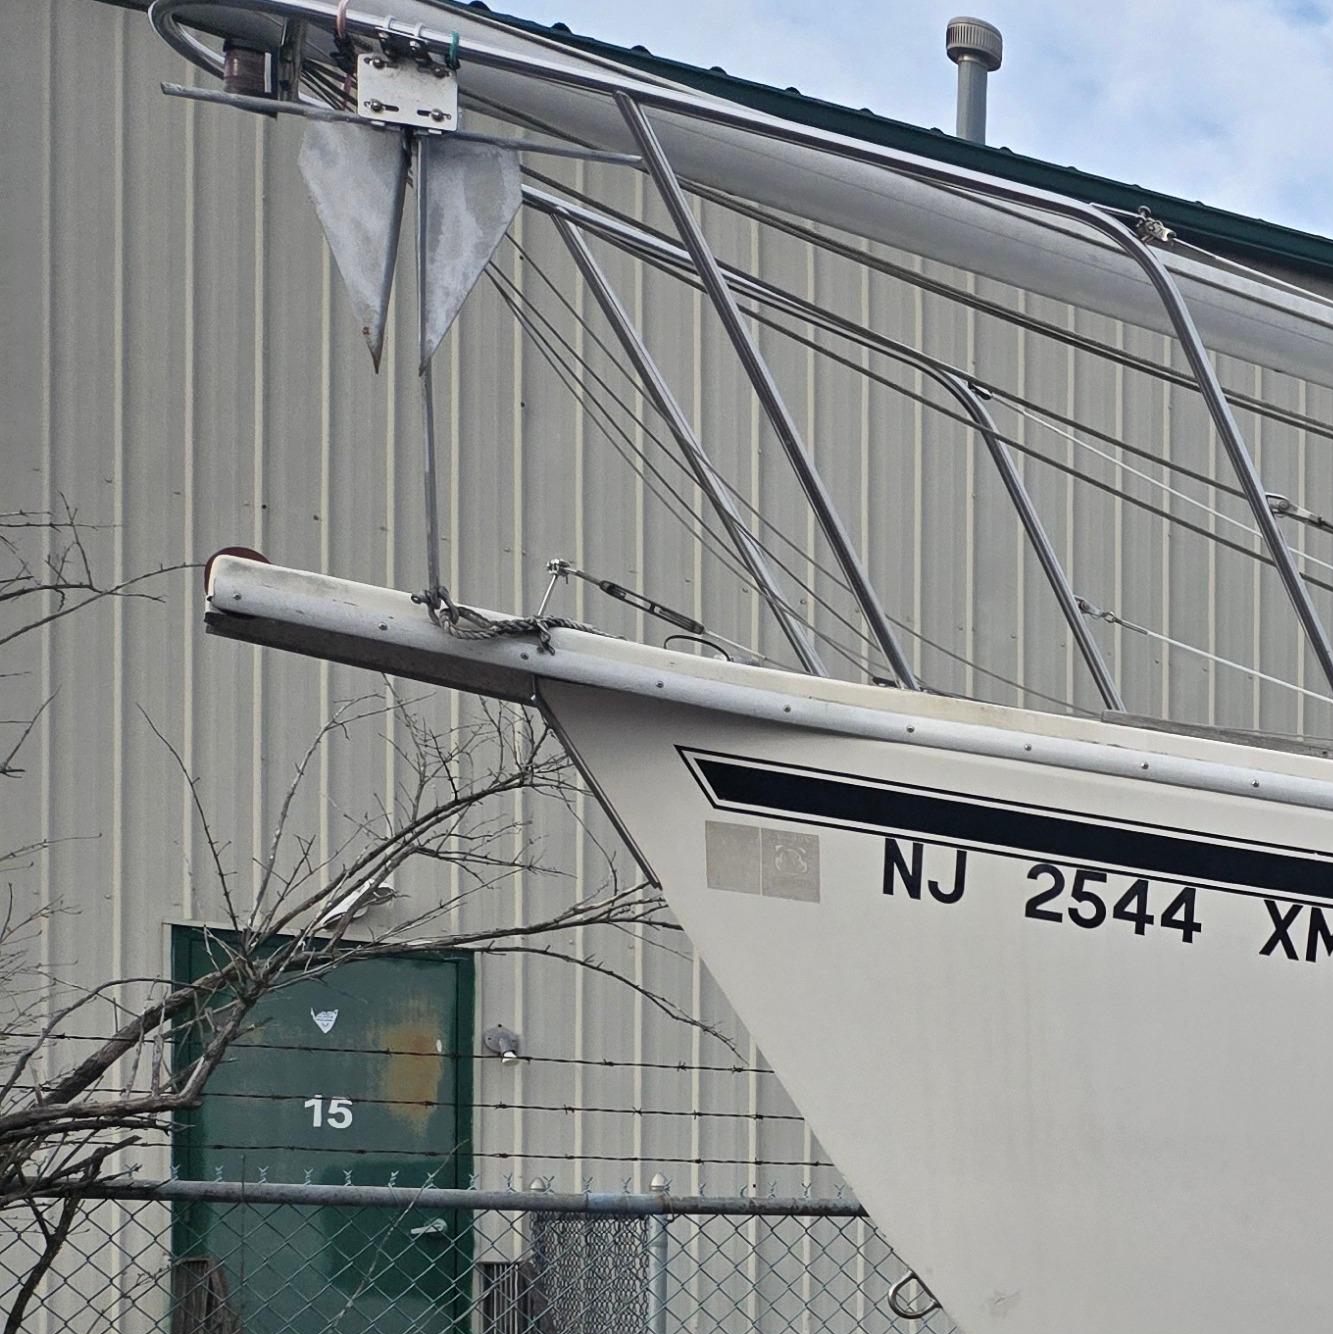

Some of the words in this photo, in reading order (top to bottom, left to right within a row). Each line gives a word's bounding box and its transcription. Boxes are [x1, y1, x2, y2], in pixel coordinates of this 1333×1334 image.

[882, 837, 968, 905] NJ
[1024, 863, 1203, 944] 2544
[304, 1094, 353, 1129] 15
